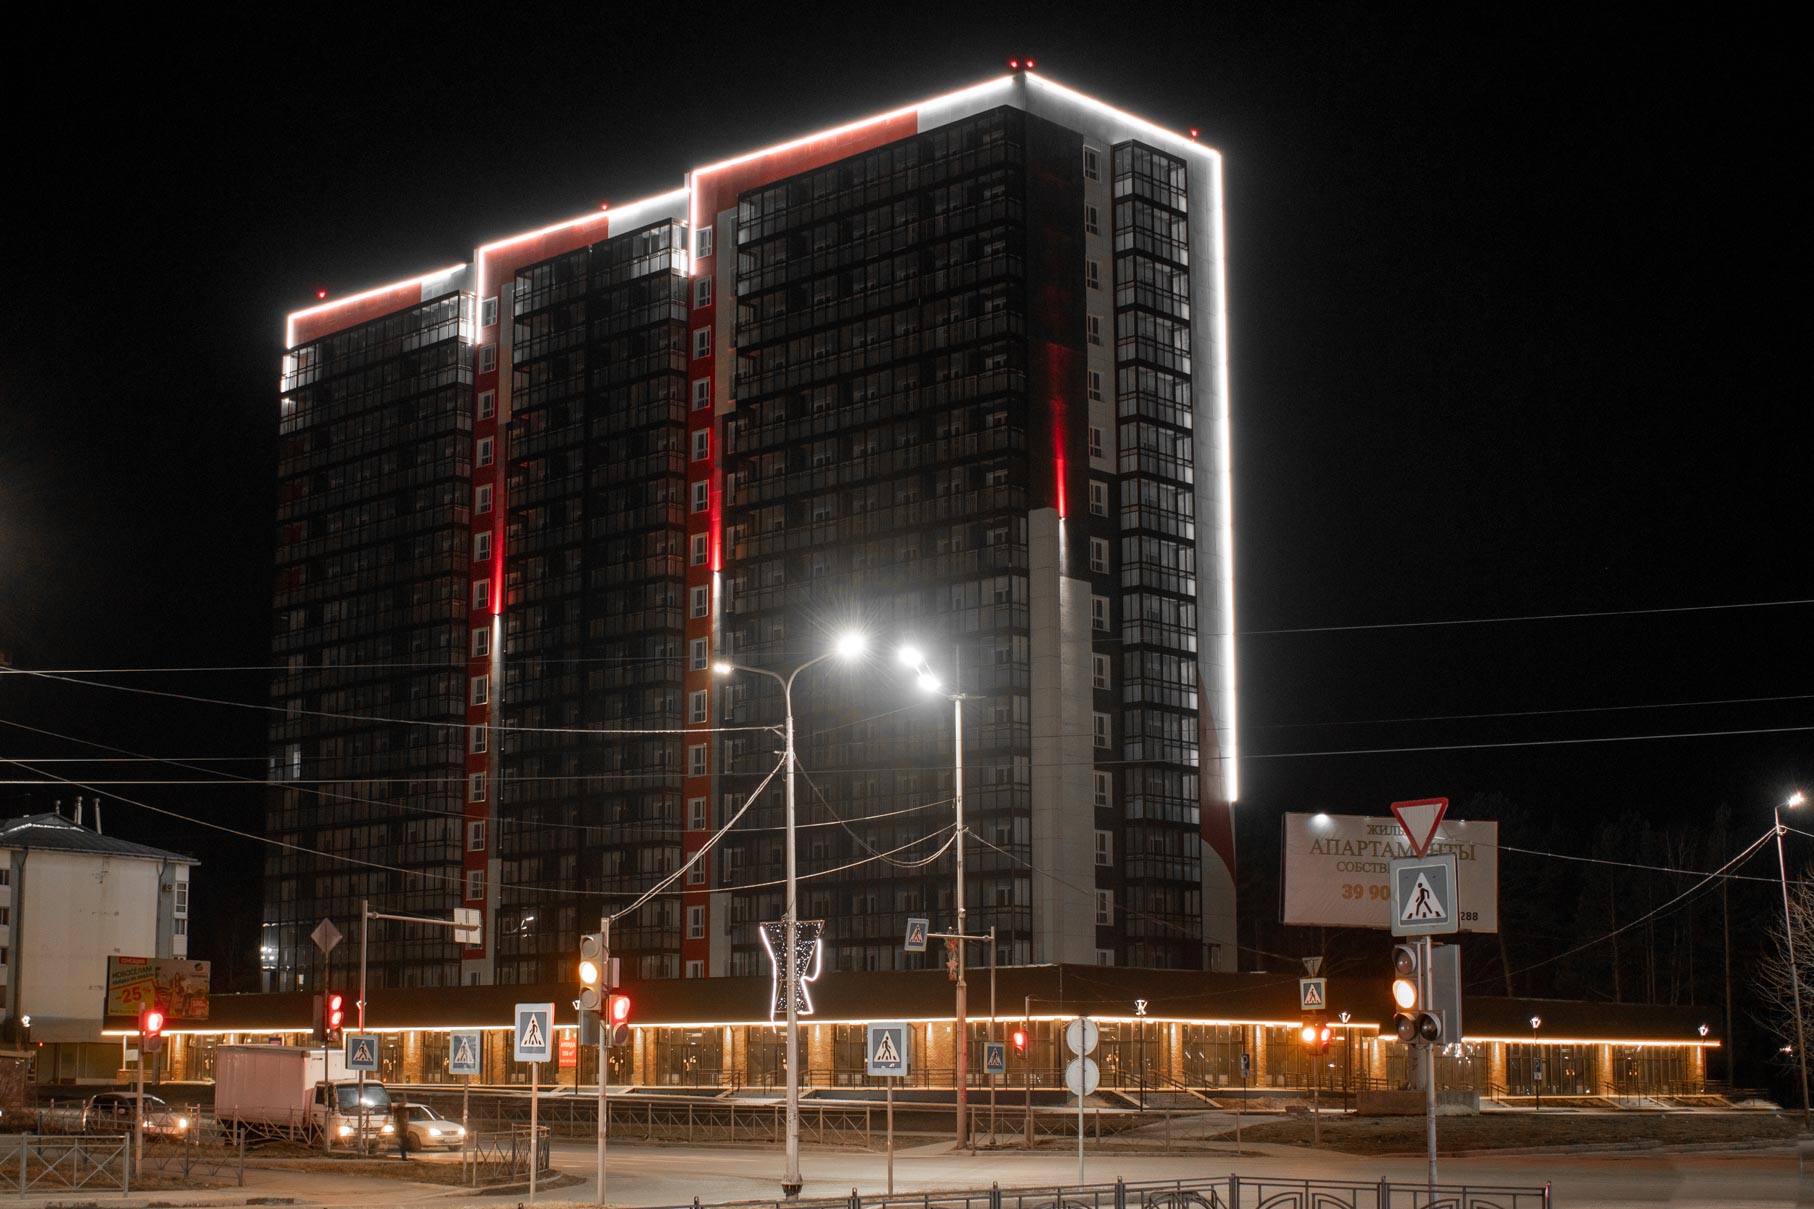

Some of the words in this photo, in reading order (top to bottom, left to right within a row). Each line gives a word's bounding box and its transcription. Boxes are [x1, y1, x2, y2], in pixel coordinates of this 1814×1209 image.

[1309, 838, 1477, 861] АПАРТАМНТЫ
[1336, 861, 1390, 873] СОБСТВ
[1342, 884, 1364, 900] 39
[1369, 884, 1391, 901] 90
